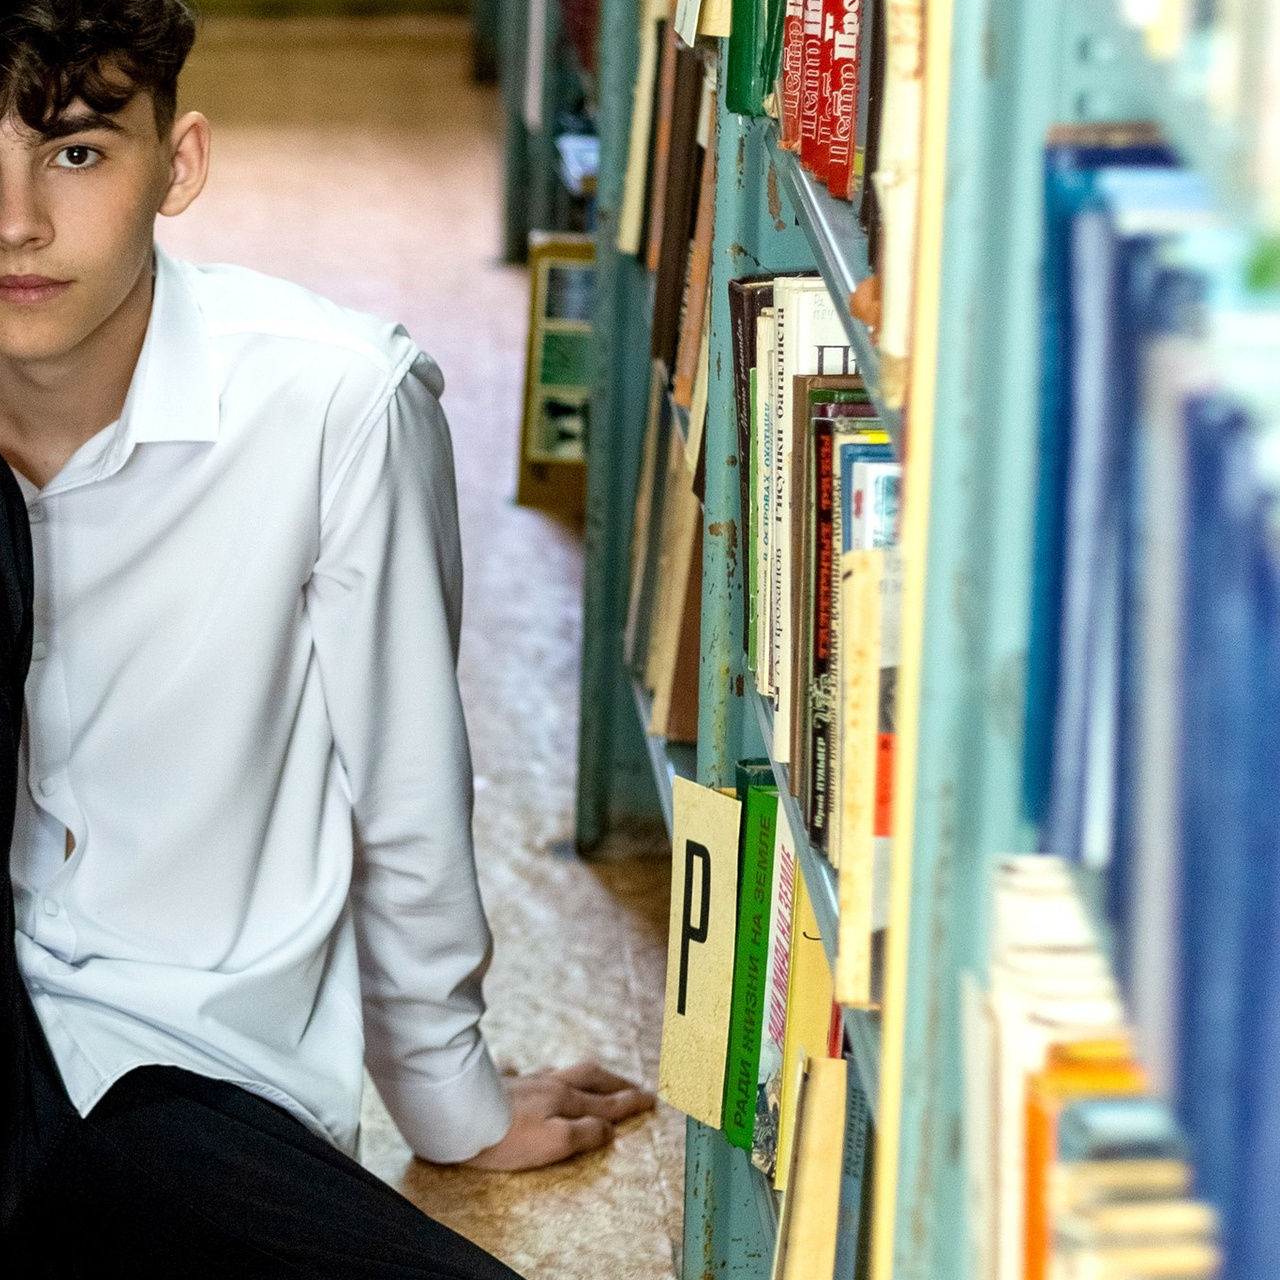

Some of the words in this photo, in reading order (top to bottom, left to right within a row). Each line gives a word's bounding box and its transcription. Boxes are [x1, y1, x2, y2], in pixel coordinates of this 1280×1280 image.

[828, 62, 857, 166] Петр
[773, 308, 787, 420] баталиста
[762, 473, 773, 547] ОСТРОВАХ
[773, 427, 787, 524] Рисунки
[814, 736, 827, 792] ПУЛЬВЕР
[813, 795, 826, 830] Юрий
[751, 813, 773, 905] ЗЕМЛЕ
[778, 843, 796, 908] ЗЕМЛЕ
[677, 840, 711, 1016] Р
[748, 912, 764, 946] НА
[775, 909, 791, 942] НА
[740, 953, 761, 1053] ЖИЗНИ
[771, 943, 790, 998] МИРА
[767, 999, 787, 1051] РАДИ
[733, 1058, 753, 1129] РАДИ
